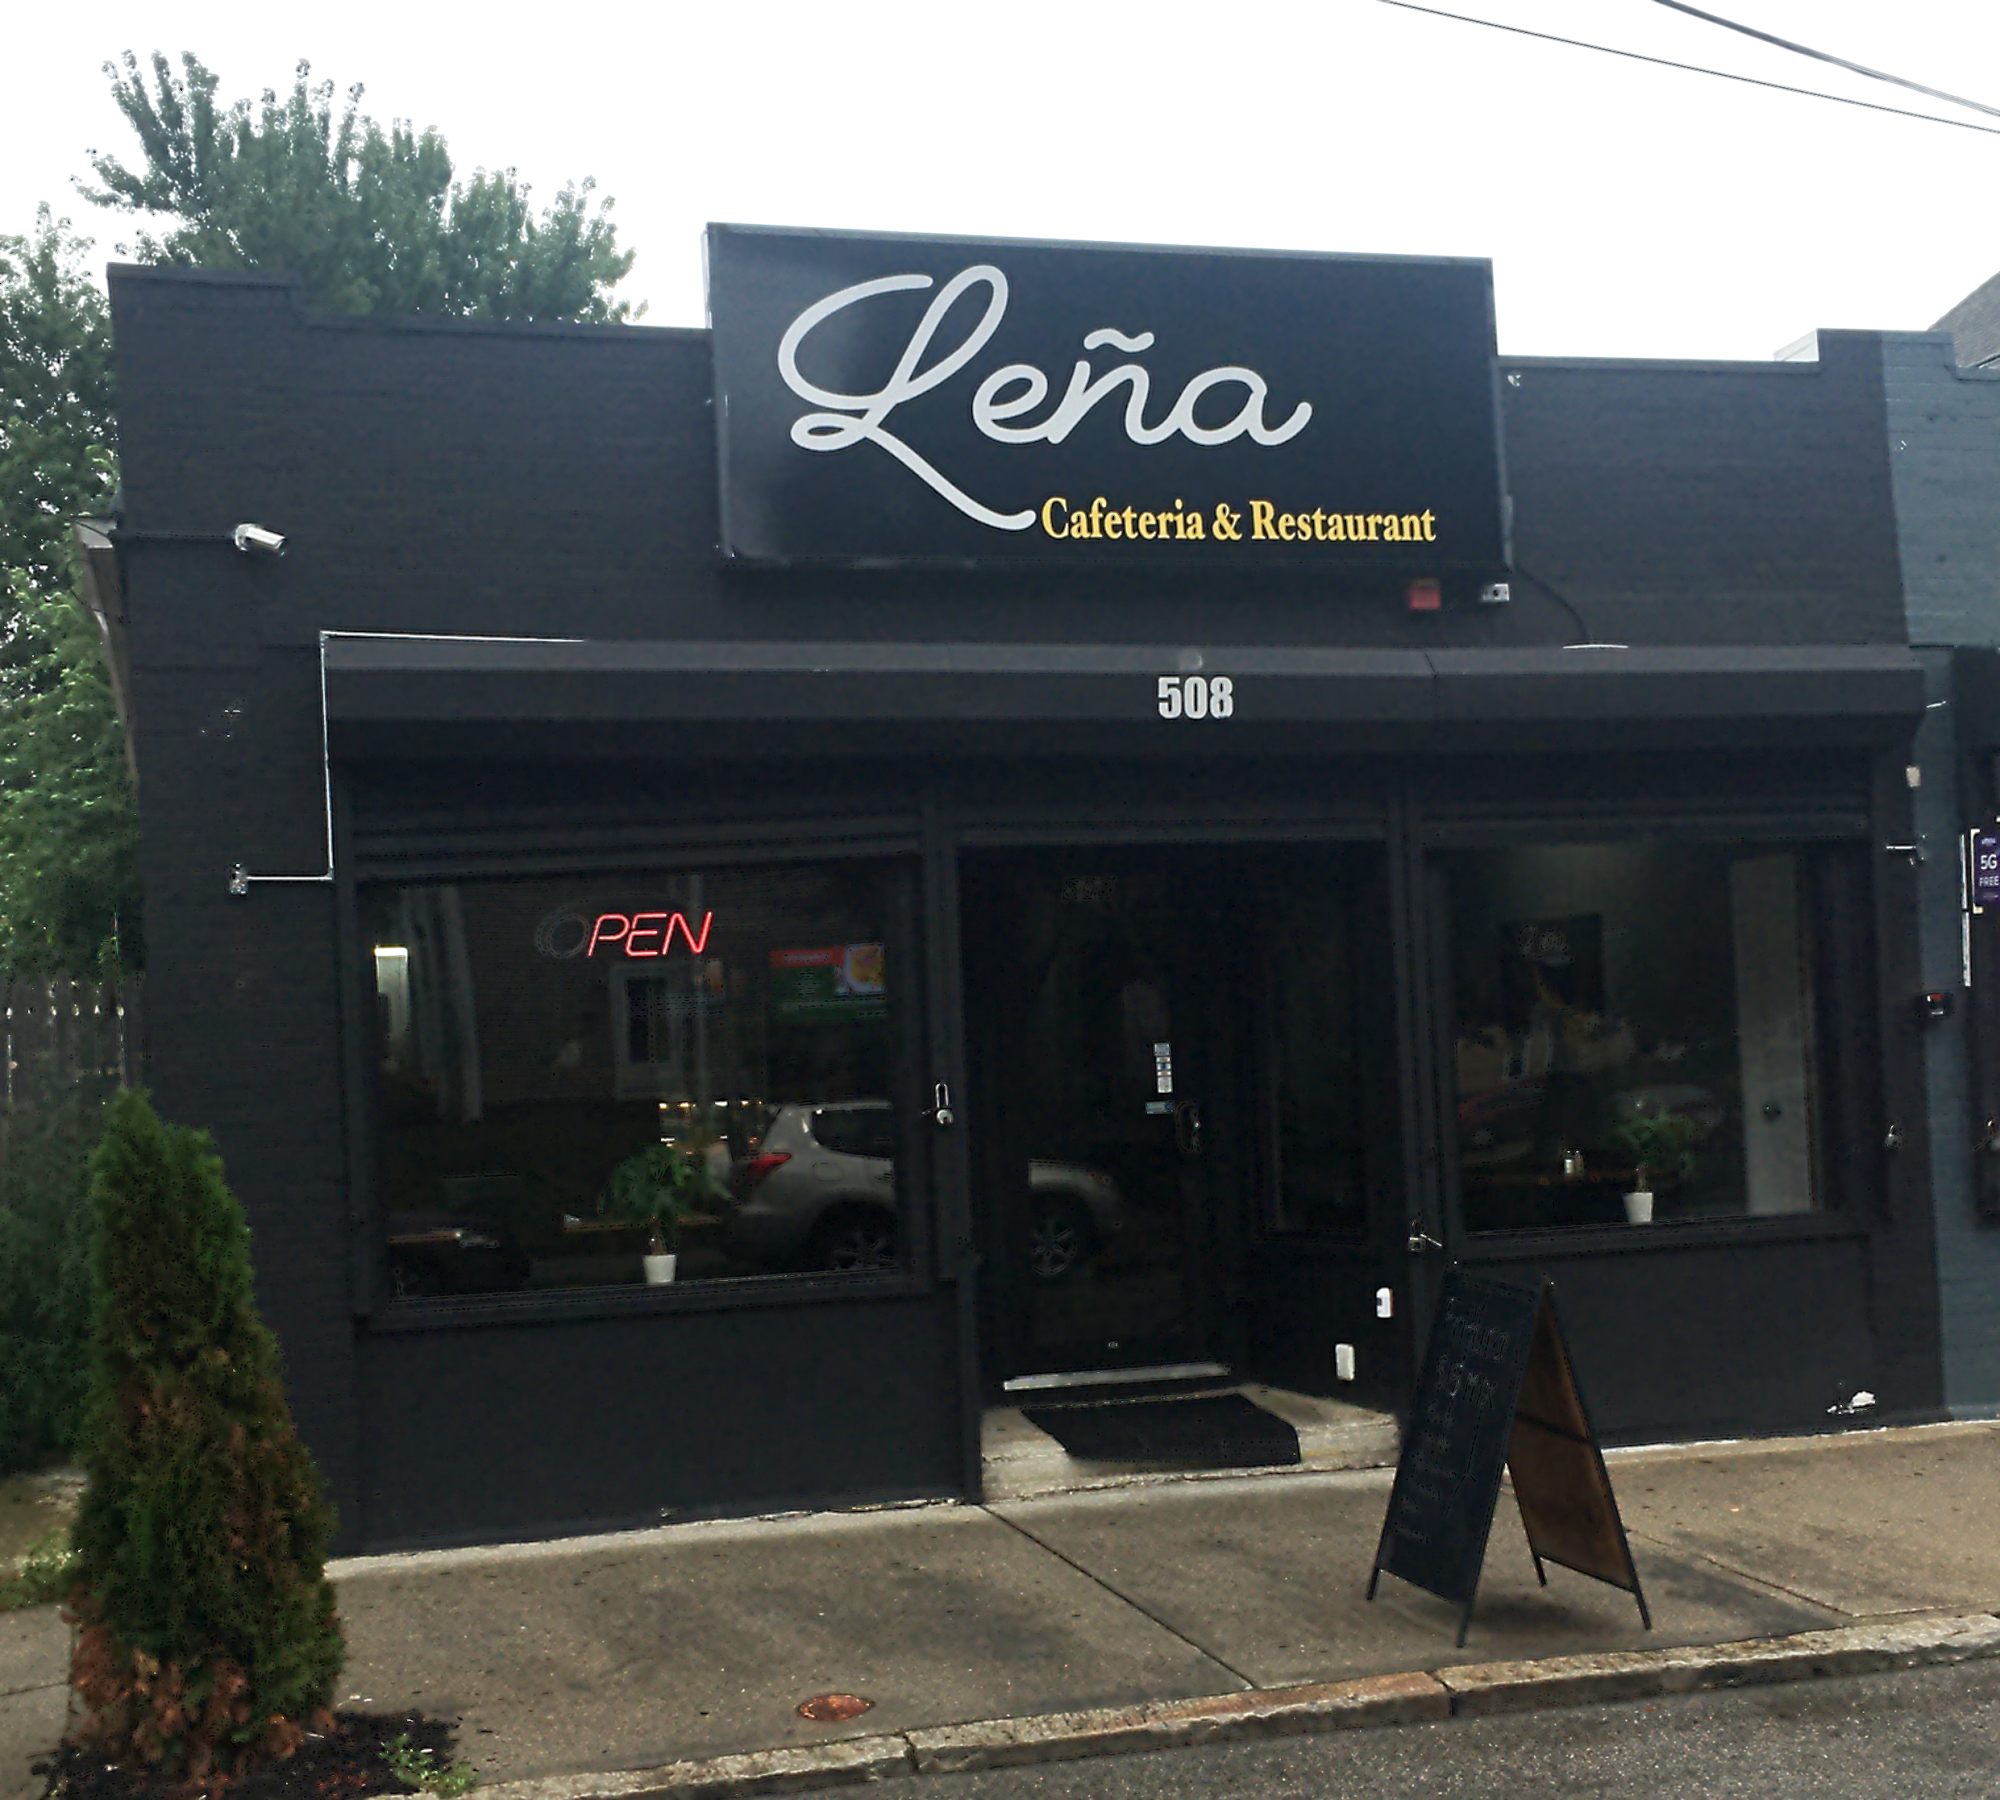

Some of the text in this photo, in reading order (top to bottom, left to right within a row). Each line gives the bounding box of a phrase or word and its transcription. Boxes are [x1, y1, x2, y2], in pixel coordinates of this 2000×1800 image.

[776, 264, 1313, 531] Leña
[1041, 495, 1437, 542] Cafeteria & Restaurant
[1157, 675, 1235, 721] 508
[1980, 853, 1998, 871] 5G
